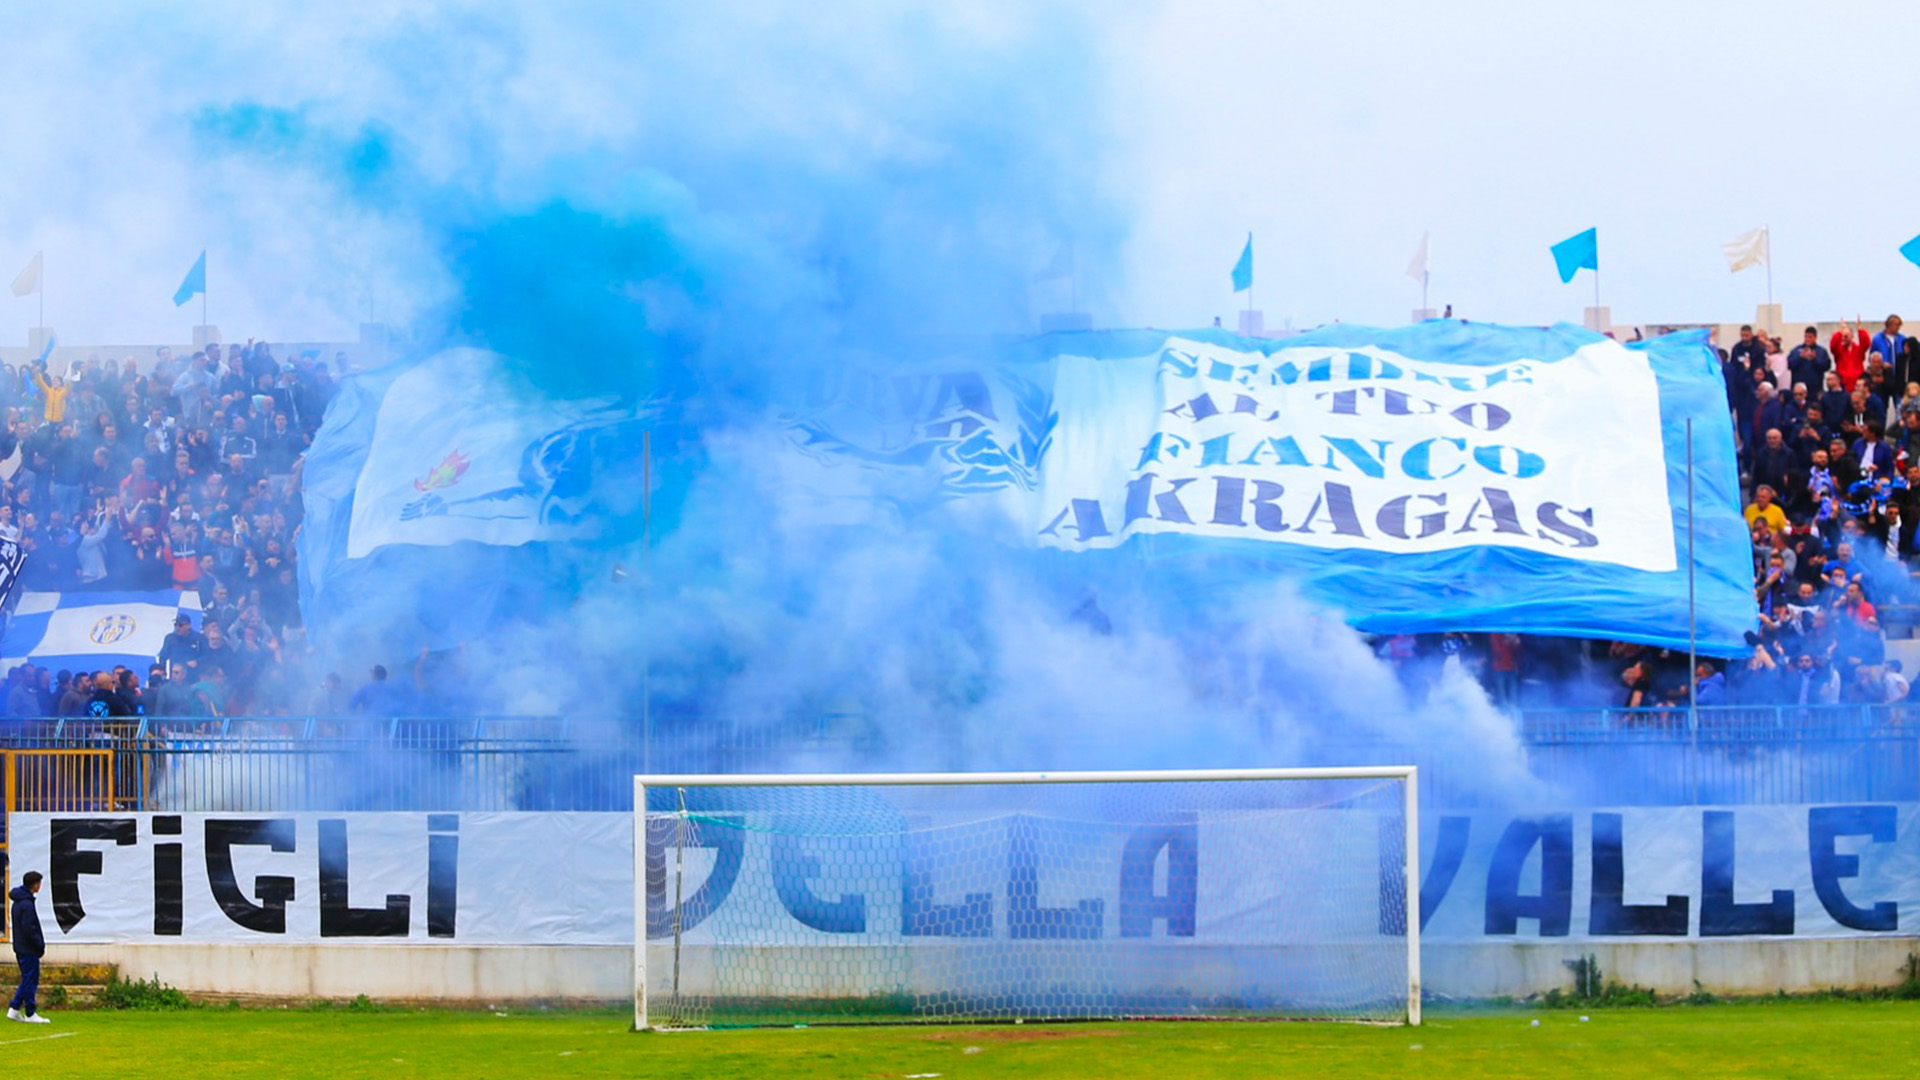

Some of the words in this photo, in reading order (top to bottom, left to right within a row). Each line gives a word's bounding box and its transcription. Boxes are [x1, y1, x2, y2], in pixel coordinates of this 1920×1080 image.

[1157, 347, 1534, 391] SEMPRE
[1163, 392, 1281, 423] AL
[1315, 386, 1513, 431] TUO
[1131, 431, 1545, 481] FIANCO
[1038, 472, 1600, 548] AKRAGAS
[645, 812, 1199, 940] DELLA
[1379, 805, 1898, 936] VALLE
